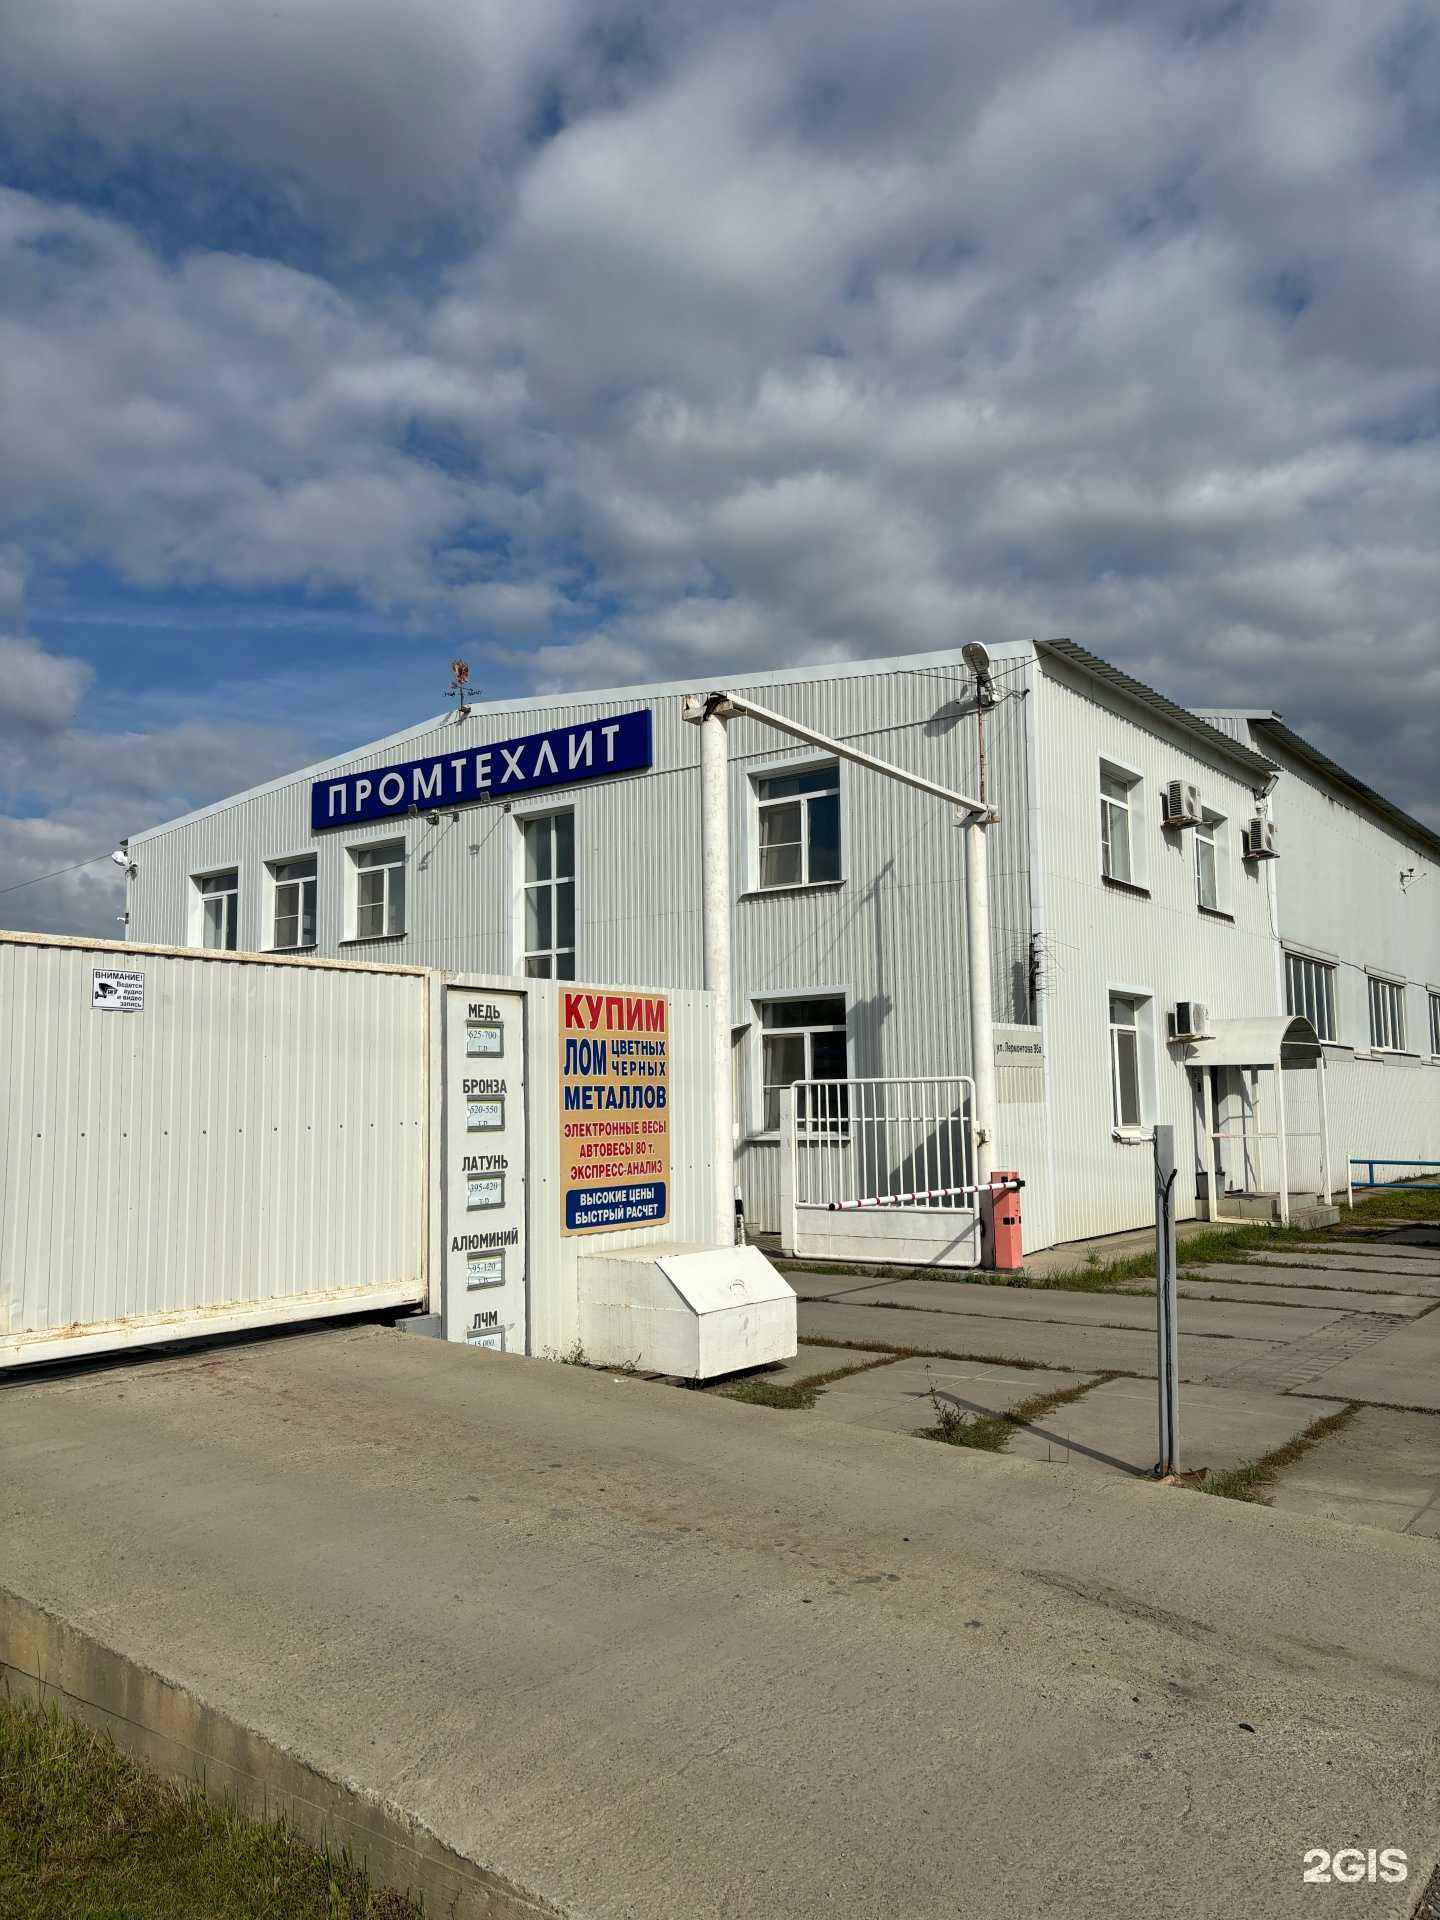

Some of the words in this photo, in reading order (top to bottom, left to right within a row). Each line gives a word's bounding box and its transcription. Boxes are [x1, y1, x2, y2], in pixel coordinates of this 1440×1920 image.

[328, 724, 620, 817] ПРОМТЕХЛИТ
[95, 971, 143, 981] ВНИМАНИЕ!
[468, 1003, 500, 1021] МЕДЬ
[564, 993, 665, 1033] КУПИМ
[469, 1030, 497, 1039] 625-700
[564, 1038, 607, 1076] ЛОМ
[611, 1039, 666, 1057] ЦВЕТНЫХ
[611, 1061, 666, 1077] ЧЕРНЫХ
[463, 1079, 507, 1094] БРОНЗА
[564, 1085, 667, 1110] МЕТАЛЛОВ
[470, 1105, 498, 1114] 520-550
[564, 1121, 640, 1137] ЭЛЕКТРОННЫЕ
[642, 1120, 666, 1134] ВЕСЫ
[580, 1141, 633, 1158] АВТОВЕСЫ
[636, 1141, 646, 1154] 80
[648, 1143, 655, 1154] т.
[462, 1155, 508, 1171] ЛАТУНЬ
[570, 1160, 663, 1180] ЭКСПРЕСС-АНАЛИЗ
[580, 1189, 627, 1206] ВЫСОКИЕ
[629, 1187, 655, 1203] ЦЕНЫ
[575, 1205, 624, 1224] БЫСТРЫЙ
[626, 1203, 659, 1219] РАСЧЕТ
[452, 1227, 519, 1252] АЛЮМИНИЙ
[473, 1310, 498, 1329] ЛЧМ
